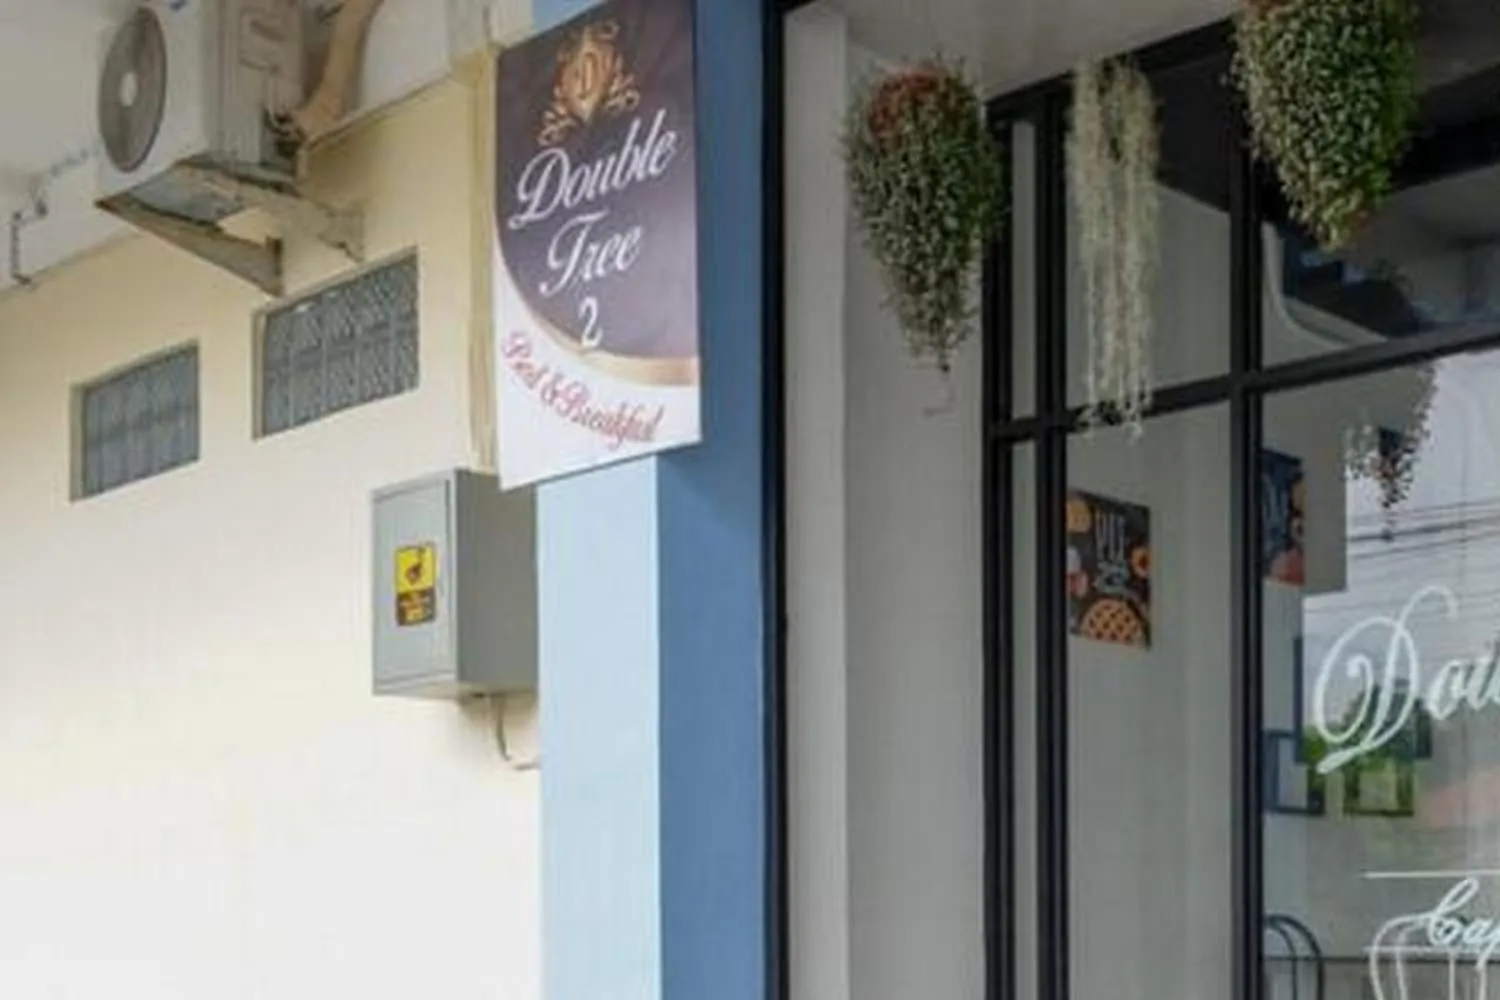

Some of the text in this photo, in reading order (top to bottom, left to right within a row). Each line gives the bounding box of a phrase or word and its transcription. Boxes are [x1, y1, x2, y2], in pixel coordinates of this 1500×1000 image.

[507, 107, 677, 230] Double
[537, 208, 643, 296] Tree
[577, 296, 602, 347] 2
